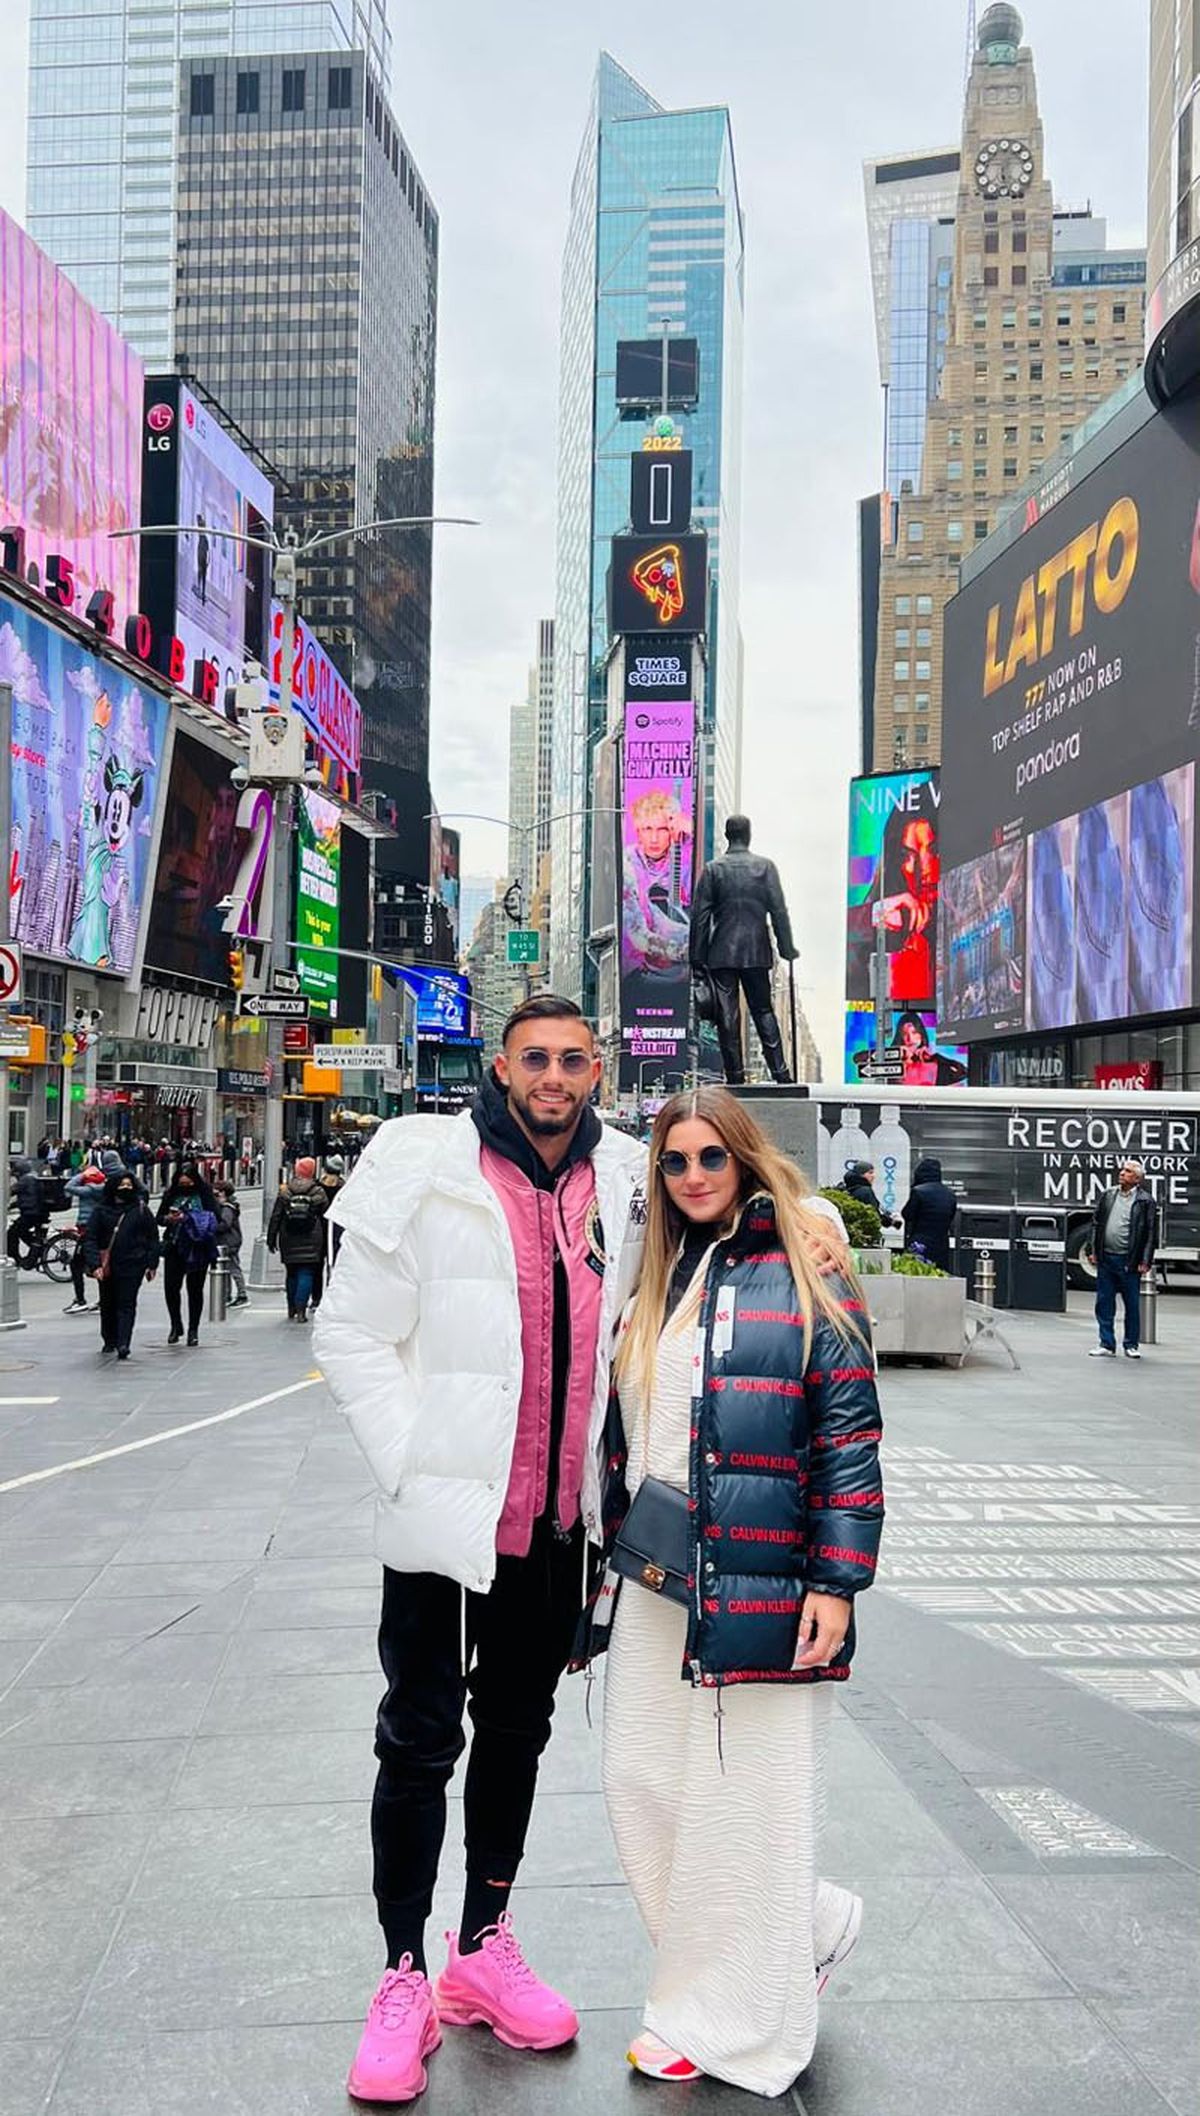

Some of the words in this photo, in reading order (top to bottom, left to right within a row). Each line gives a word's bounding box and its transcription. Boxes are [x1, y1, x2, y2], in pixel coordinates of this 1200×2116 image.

[148, 436, 171, 451] LG
[642, 436, 682, 451] 2022
[983, 496, 1139, 698] LATTO
[635, 657, 680, 671] TIMES
[1047, 660, 1076, 696] NOW
[1077, 645, 1097, 676] ON
[628, 671, 687, 687] SQUARE
[991, 728, 1011, 754] TOP
[1012, 709, 1043, 742] SHELF
[1045, 697, 1067, 723] RAP
[1068, 679, 1095, 709] AND
[1097, 658, 1123, 691] R&B
[628, 742, 691, 760] MACHINE
[627, 760, 652, 778] GUN
[653, 760, 691, 778] KELLY
[1015, 733, 1081, 795] pandora
[855, 782, 921, 816] NINE
[424, 904, 433, 945] 1500
[249, 1000, 267, 1010] ONE
[279, 1002, 300, 1011] WAY
[1007, 1116, 1191, 1152] RECOVER
[1043, 1153, 1062, 1167] IN
[1069, 1154, 1082, 1168] A
[1089, 1154, 1132, 1169] NEW
[1138, 1155, 1189, 1171] YORK
[1043, 1171, 1190, 1204] MINTE
[732, 1378, 772, 1393] CALVIN
[730, 1452, 768, 1468] CALVIN
[729, 1525, 768, 1541] CALVIN
[768, 1528, 797, 1544] KLEIN
[727, 1599, 766, 1615] CALVIN
